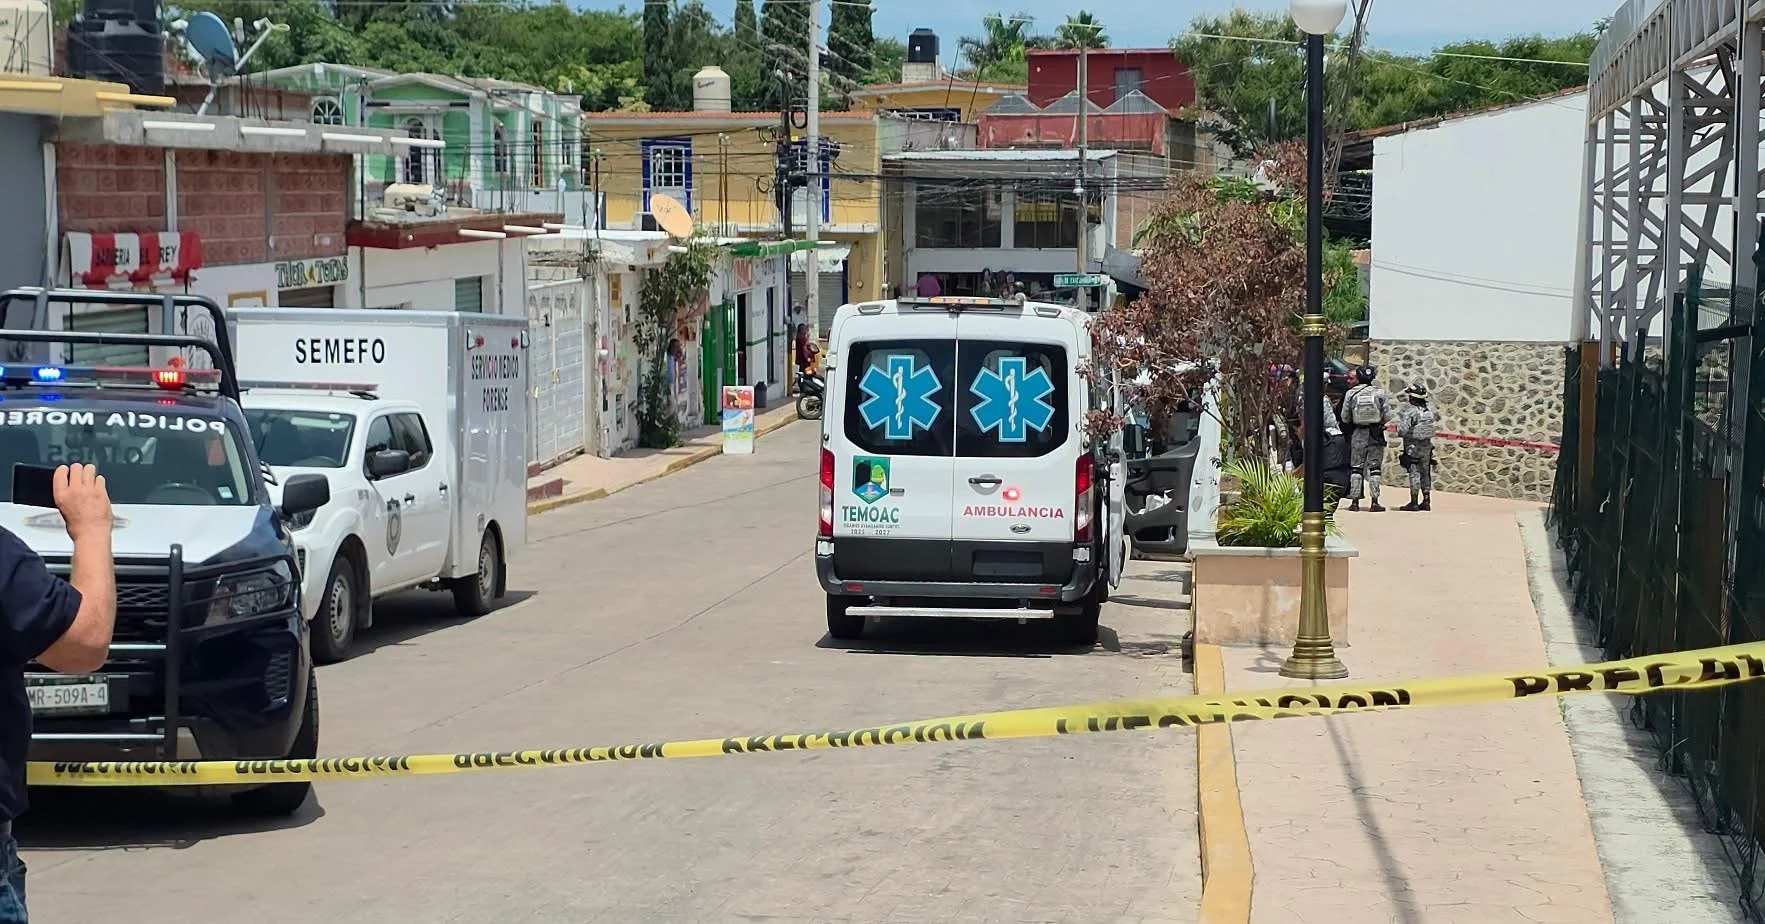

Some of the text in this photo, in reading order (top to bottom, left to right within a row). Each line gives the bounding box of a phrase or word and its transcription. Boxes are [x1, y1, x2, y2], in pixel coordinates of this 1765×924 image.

[159, 245, 177, 262] REY
[295, 338, 385, 364] SEMEFO
[471, 354, 498, 380] SERVICIO
[482, 387, 508, 411] FORENSE
[842, 505, 900, 524] TEMOAC
[963, 505, 1064, 519] AMBULANCIA
